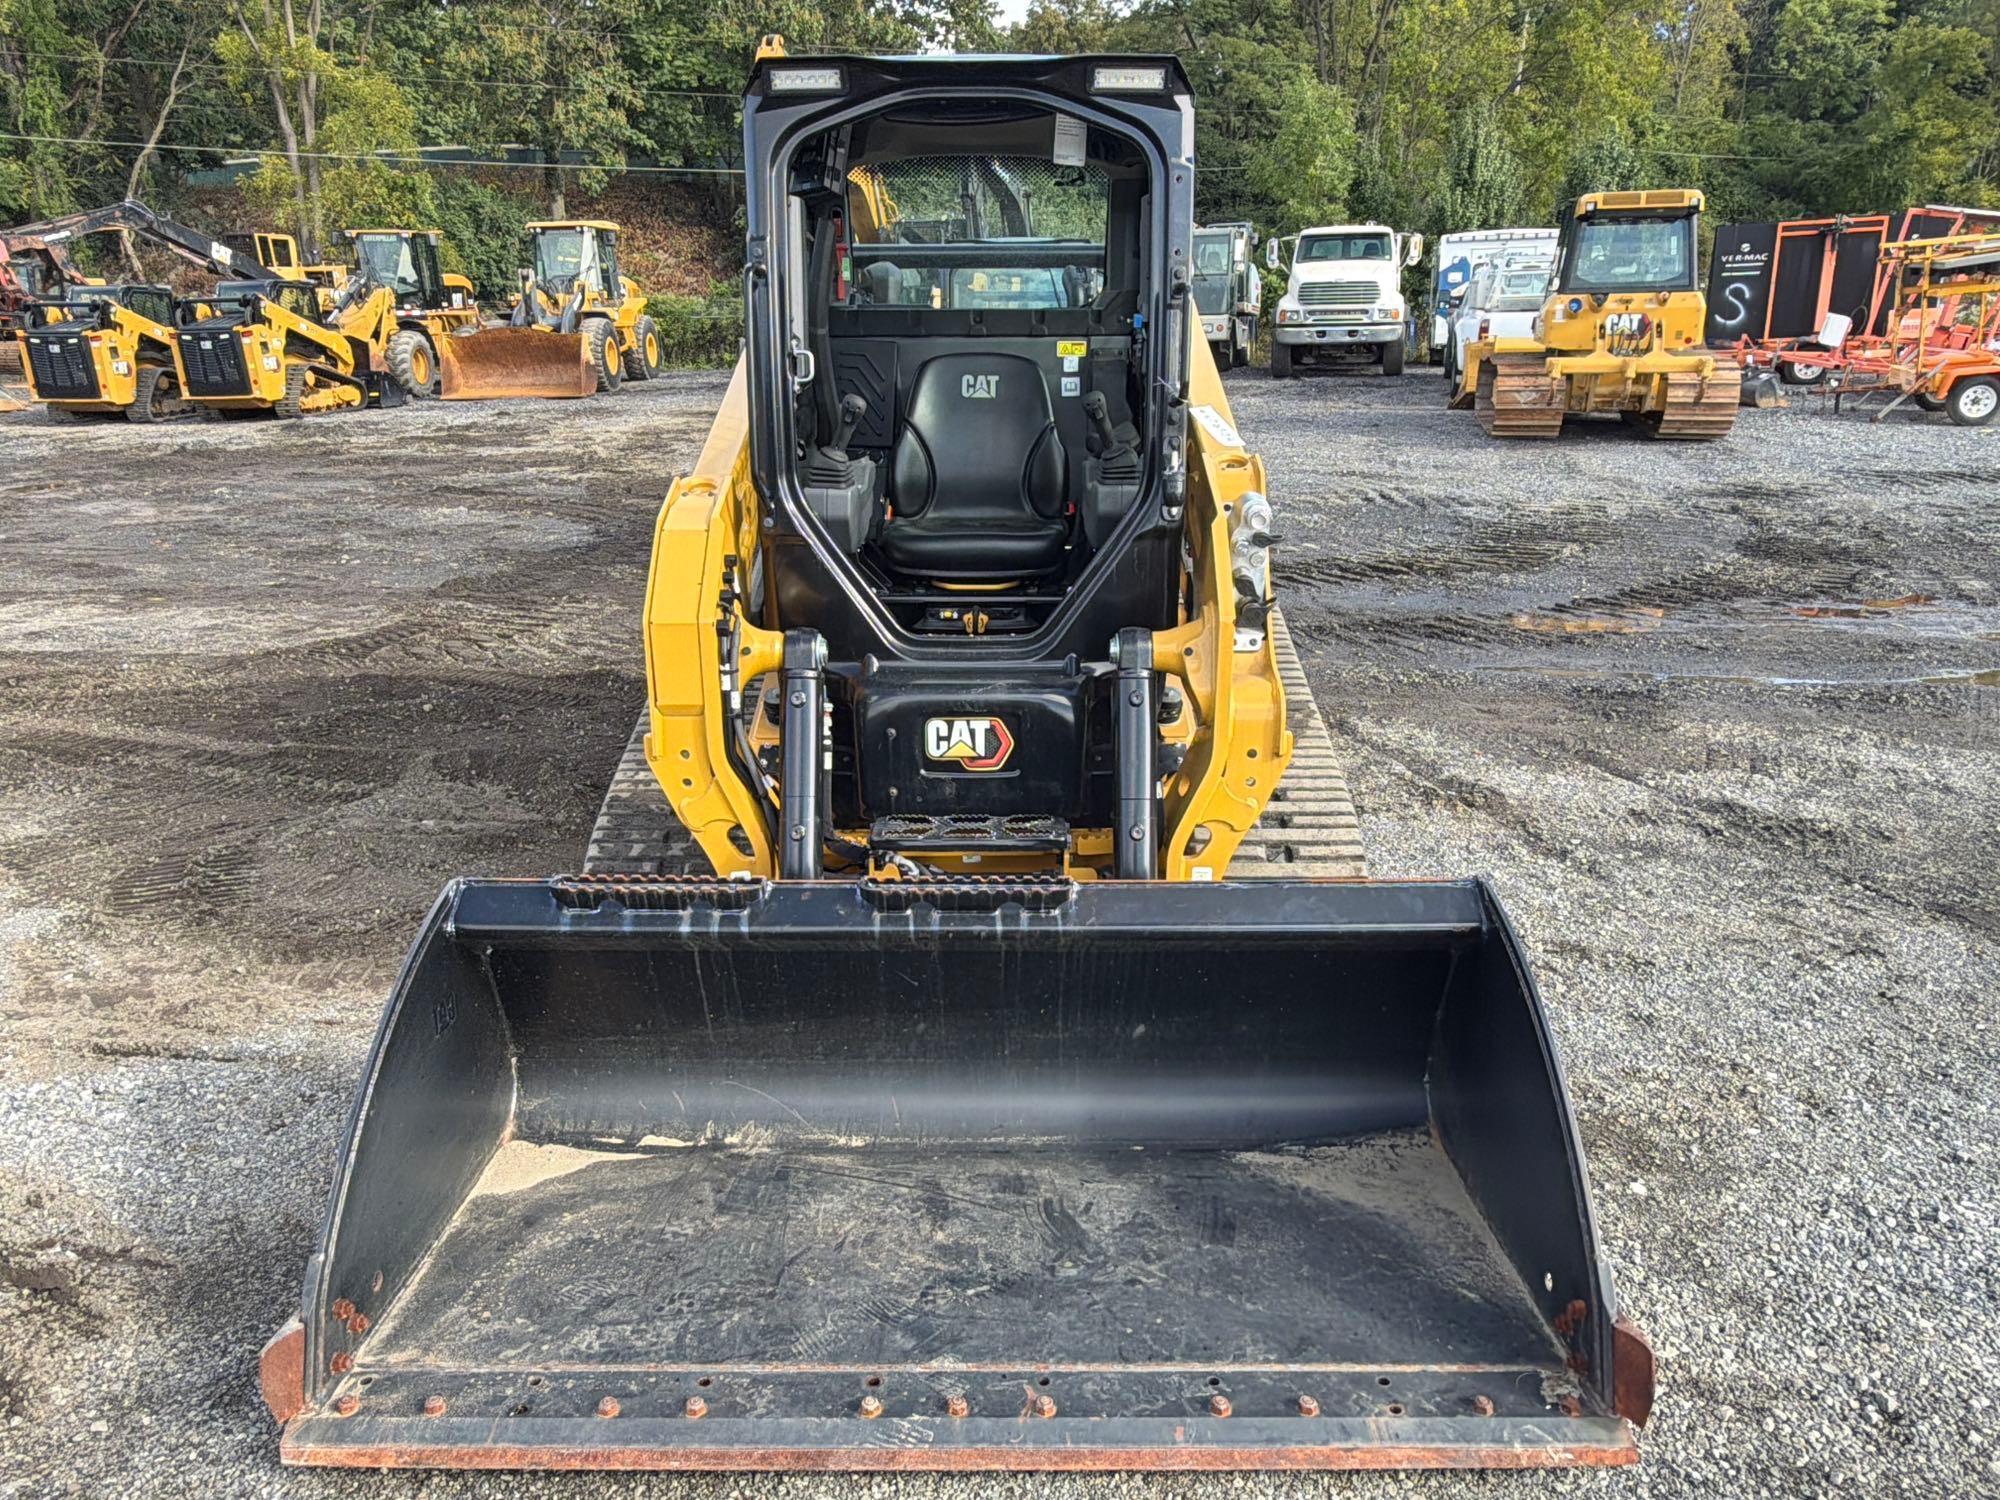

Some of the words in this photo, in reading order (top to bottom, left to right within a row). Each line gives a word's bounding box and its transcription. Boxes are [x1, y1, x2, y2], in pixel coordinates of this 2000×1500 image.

[211, 241, 232, 266] CAT
[1721, 252, 1768, 262] VER-MAC
[1605, 313, 1643, 335] CAT
[961, 374, 1000, 399] CAT
[927, 719, 991, 757] CAT
